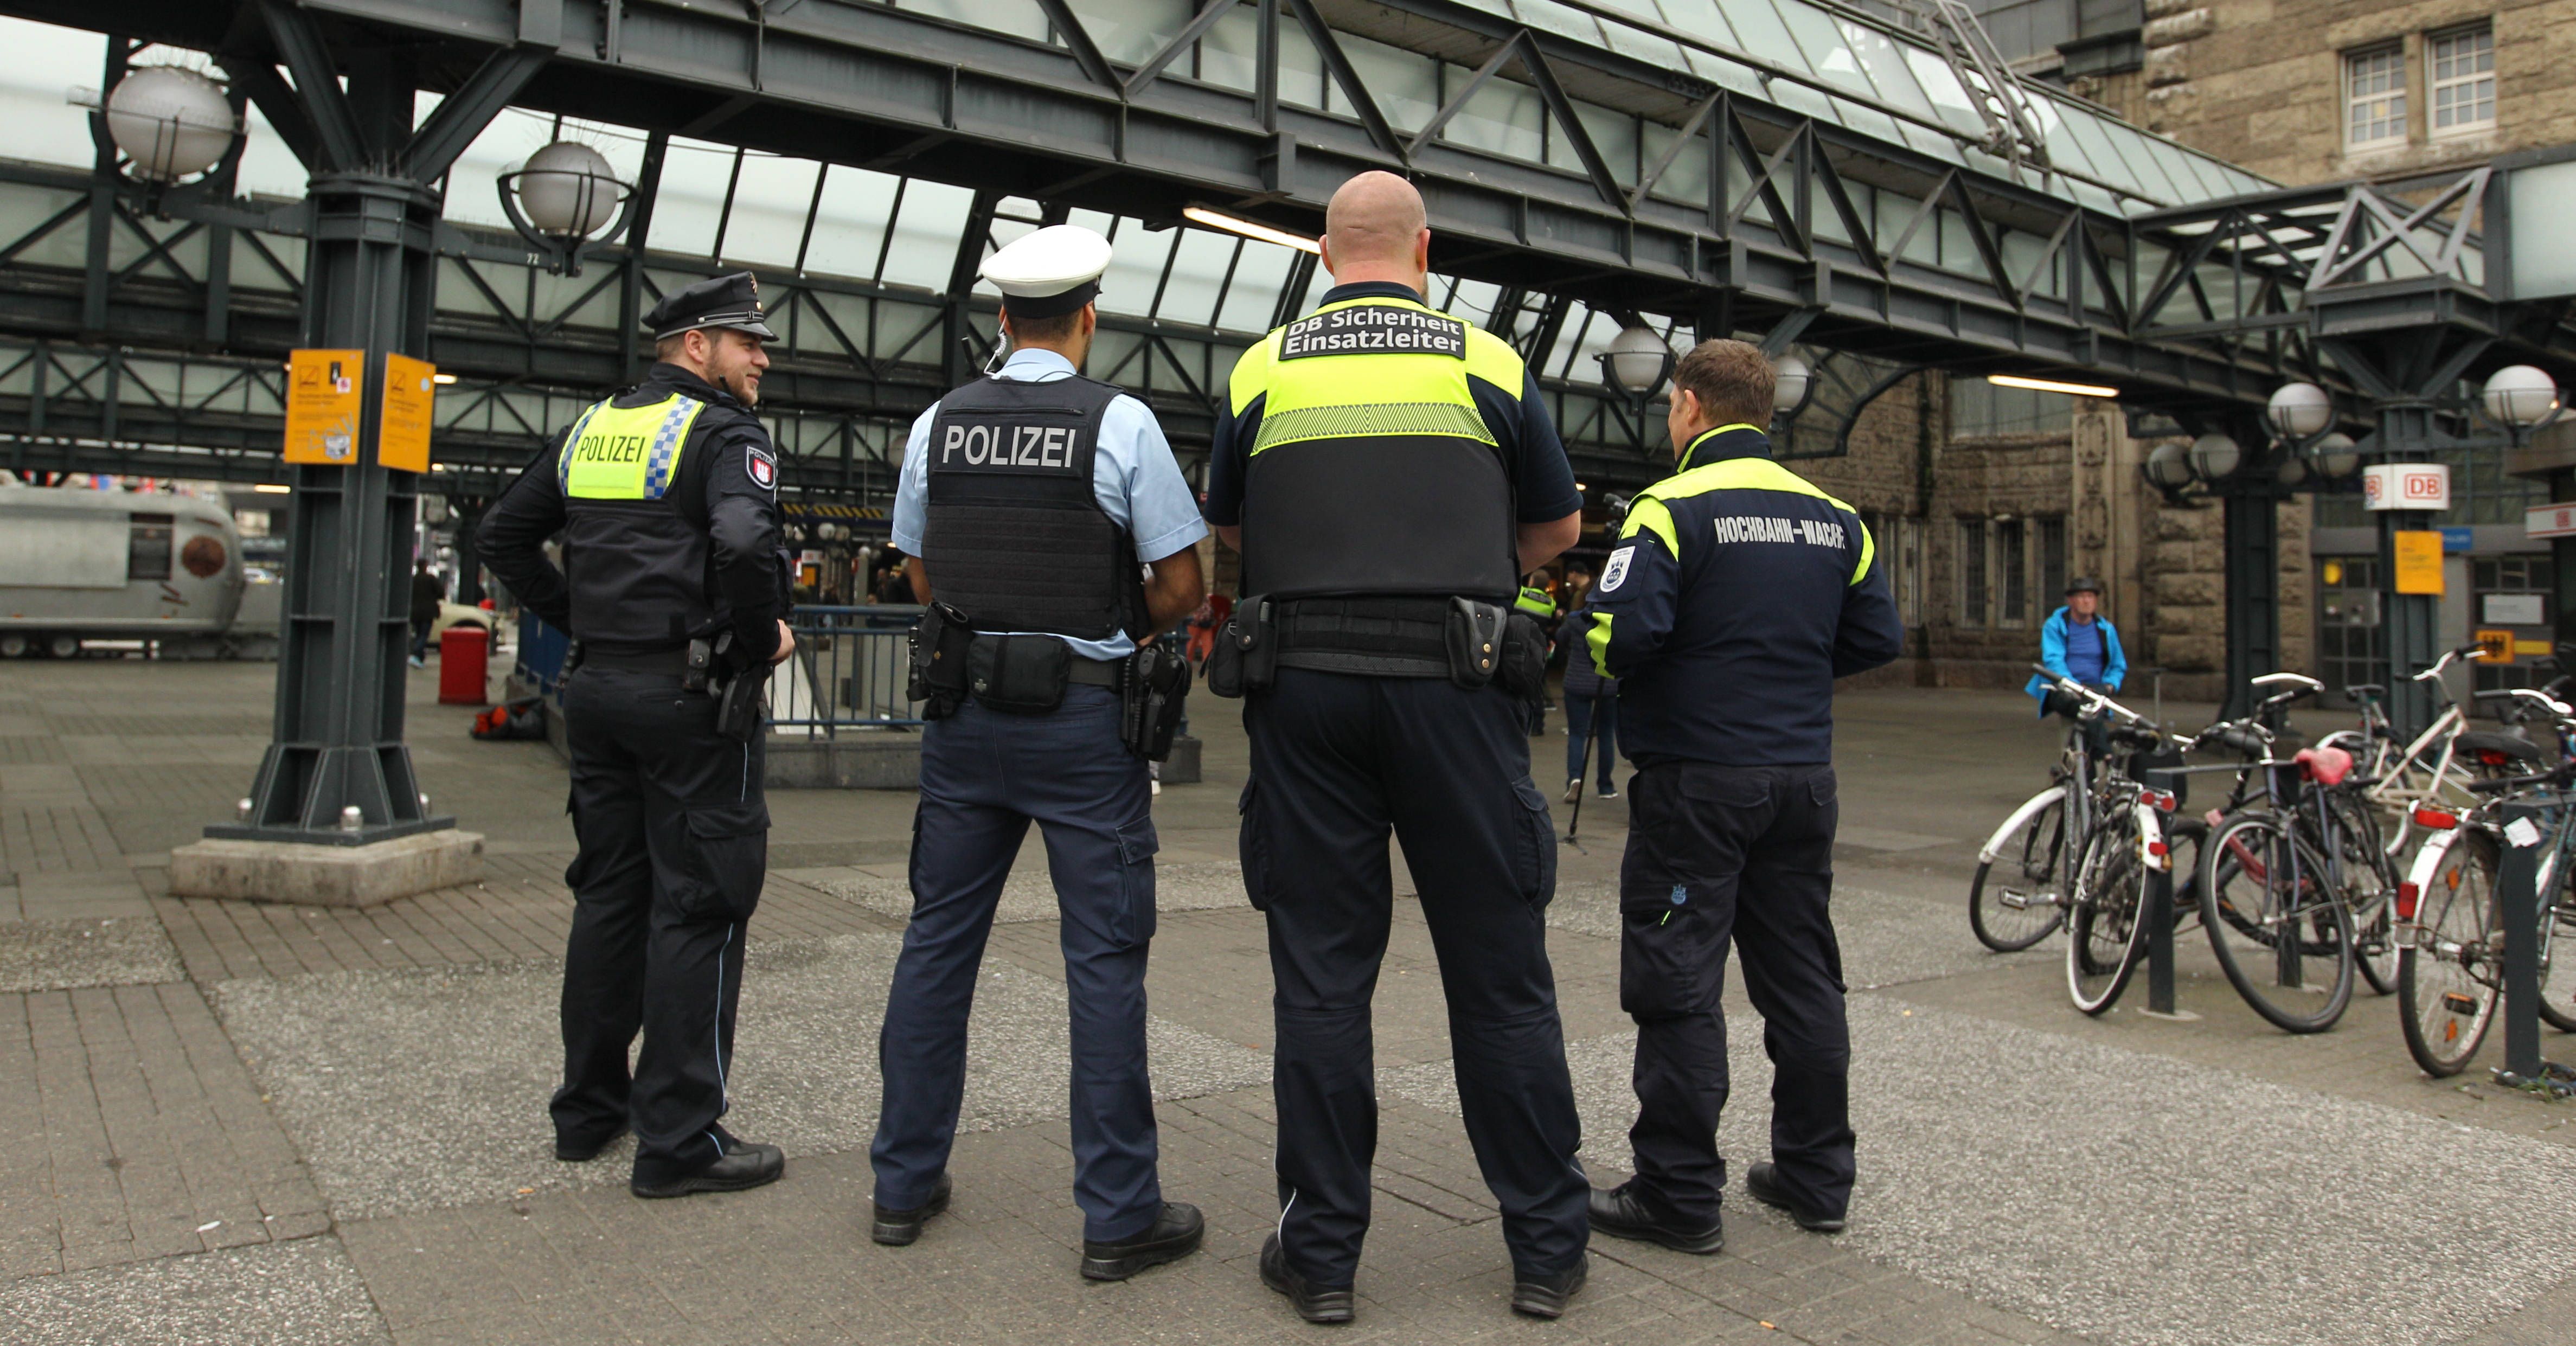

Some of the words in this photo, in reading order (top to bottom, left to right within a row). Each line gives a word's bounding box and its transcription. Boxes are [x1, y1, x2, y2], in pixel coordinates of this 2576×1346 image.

[1288, 316, 1323, 336] DB
[1330, 307, 1460, 335] Sicherheit
[1285, 328, 1460, 354] Einsatzleiter
[578, 435, 645, 462] POLIZEI
[943, 425, 1076, 467] POLIZEI
[2411, 478, 2439, 494] DB
